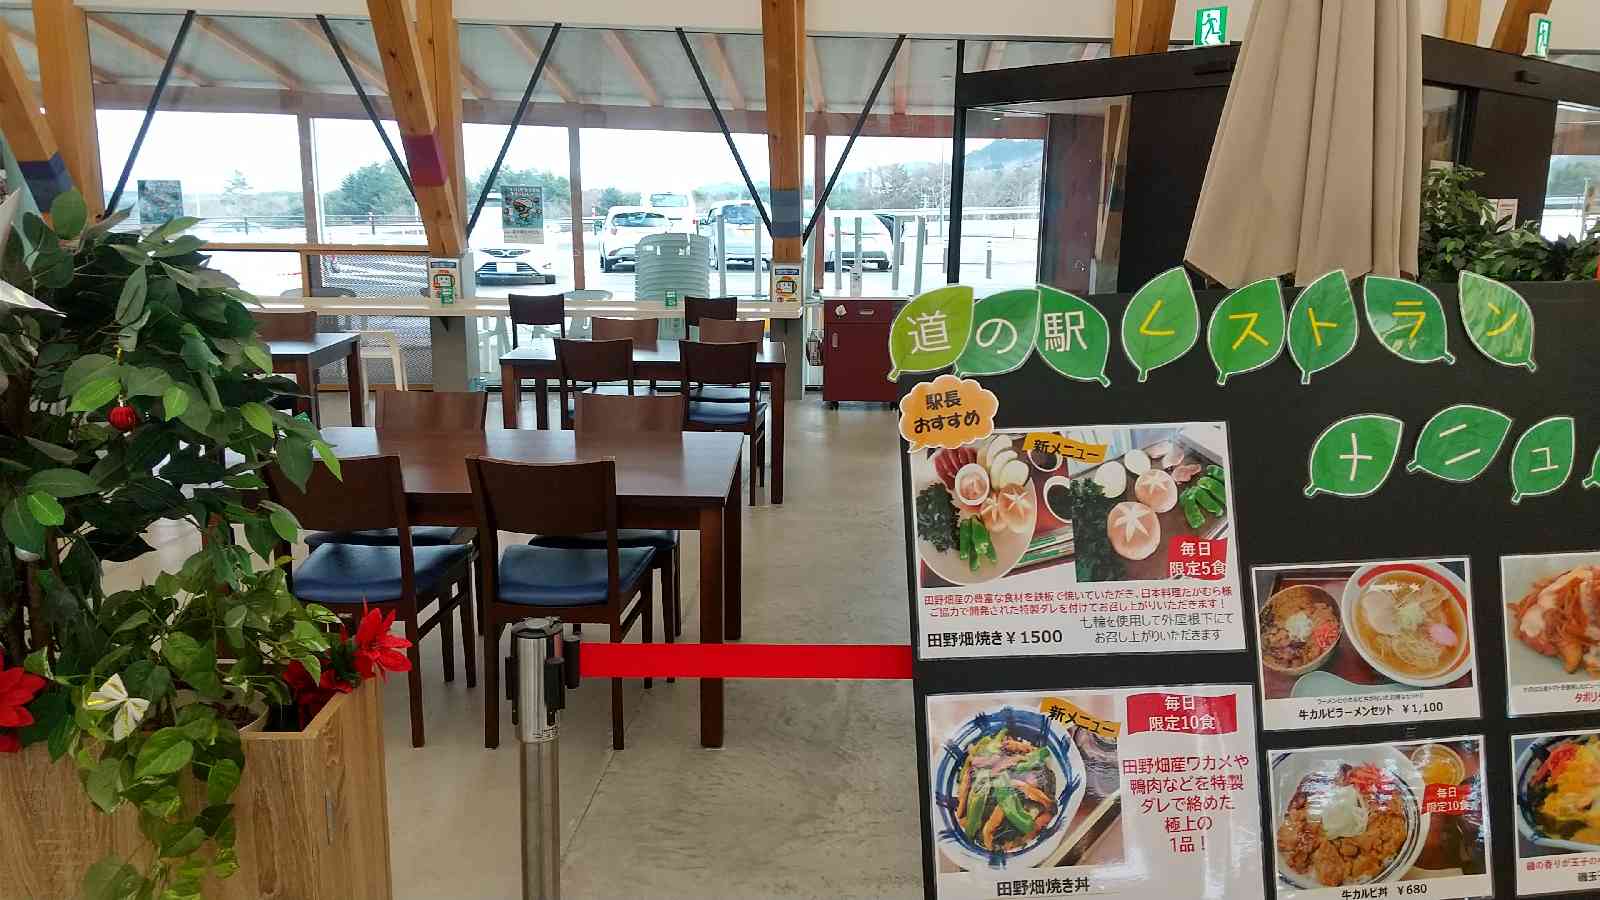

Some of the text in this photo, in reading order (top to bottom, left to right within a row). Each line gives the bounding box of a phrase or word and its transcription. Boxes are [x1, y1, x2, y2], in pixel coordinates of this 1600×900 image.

[906, 298, 1519, 355] 道の駅 レストラン
[925, 389, 962, 411] 駅長
[913, 410, 981, 434] おすすめ
[1033, 438, 1100, 461] 新メニュー
[1180, 541, 1211, 557] 毎日
[1169, 560, 1226, 577] 限定5食
[1164, 695, 1196, 711] 毎日
[1299, 703, 1394, 721] 牛カルビラーメンセット
[1048, 705, 1116, 734] 新メニュー
[1149, 714, 1217, 731] 限定10食
[1122, 753, 1250, 775] 田野畑産ワカメや
[1129, 774, 1244, 796] 鴨肉などを特製
[1140, 794, 1235, 814] ダレで絡めた
[1164, 815, 1213, 833] 極上の
[996, 876, 1091, 897] 田野畑焼き丼
[1341, 886, 1388, 900] 牛カルビ丼
